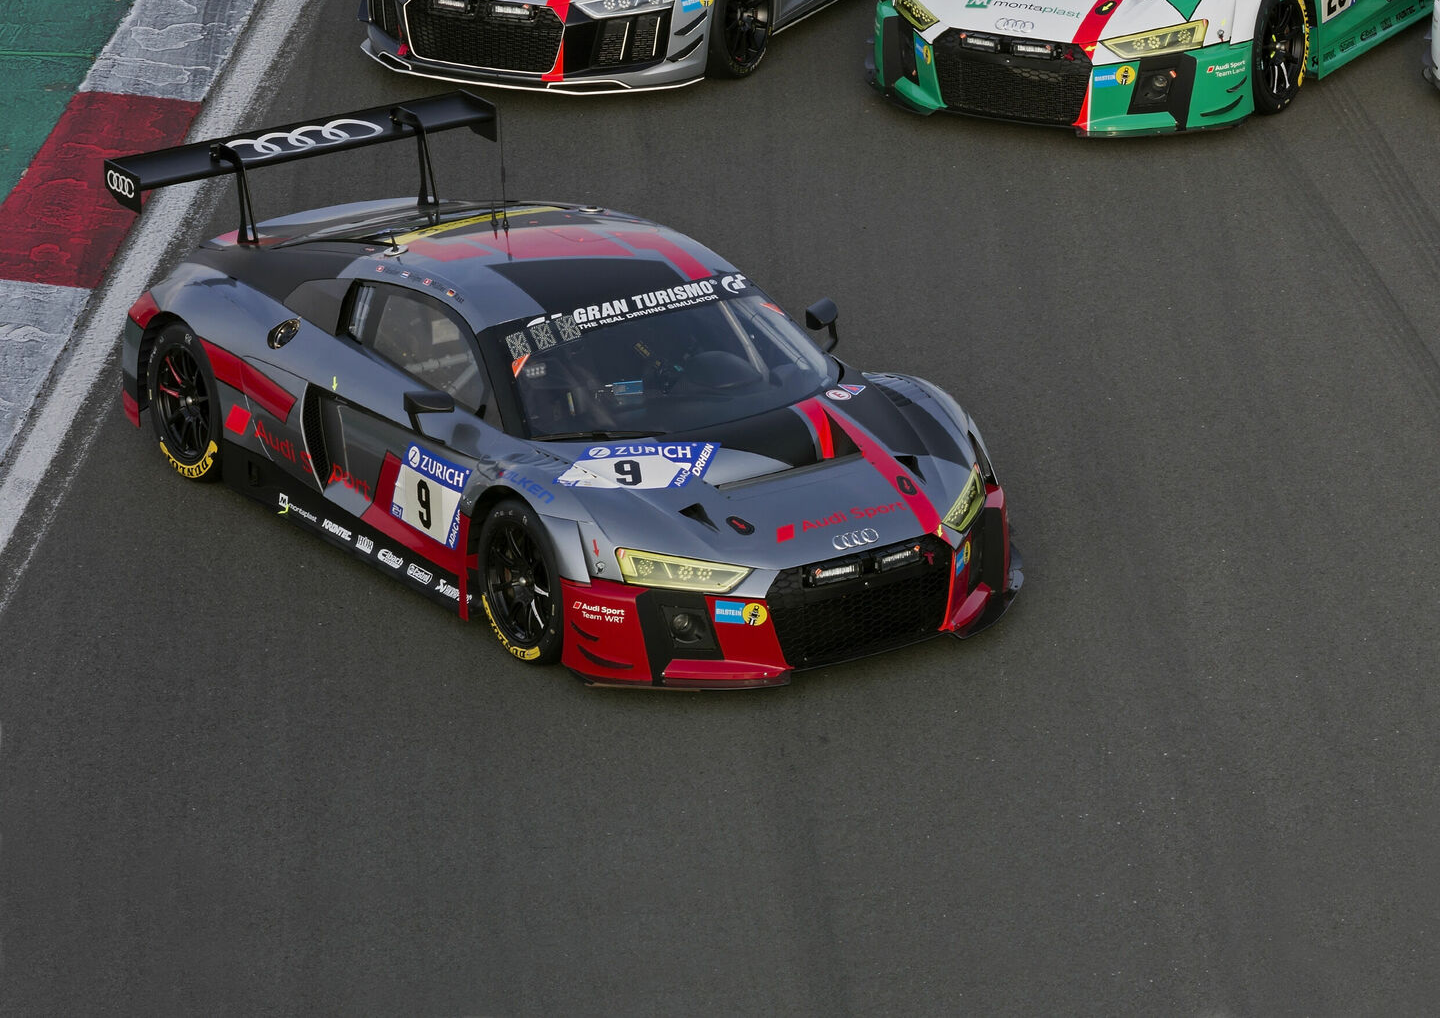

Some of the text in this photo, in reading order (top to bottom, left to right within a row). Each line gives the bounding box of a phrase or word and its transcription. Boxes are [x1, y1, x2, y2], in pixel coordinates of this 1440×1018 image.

[993, 0, 1082, 19] montaplast
[1215, 60, 1246, 72] Audi Sport
[1215, 69, 1231, 77] Team
[573, 280, 714, 324] GRAN TURISMO
[578, 293, 719, 331] THE REAL DRIVING SIMULATOR
[254, 419, 297, 463] Audi
[615, 445, 692, 459] ZURICH
[421, 454, 465, 488] ZURICH
[613, 459, 643, 486] 9
[674, 469, 691, 487] ADAC
[288, 502, 318, 523] montaplast
[416, 478, 432, 531] 9
[802, 500, 907, 532] Audi Sport
[321, 517, 353, 542] KRONTEC
[448, 521, 460, 549] ADAC
[377, 547, 404, 566] Eibach
[581, 602, 625, 617] Audi Sport
[581, 611, 625, 624] Team WRT
[716, 608, 742, 617] BILSTEIN
